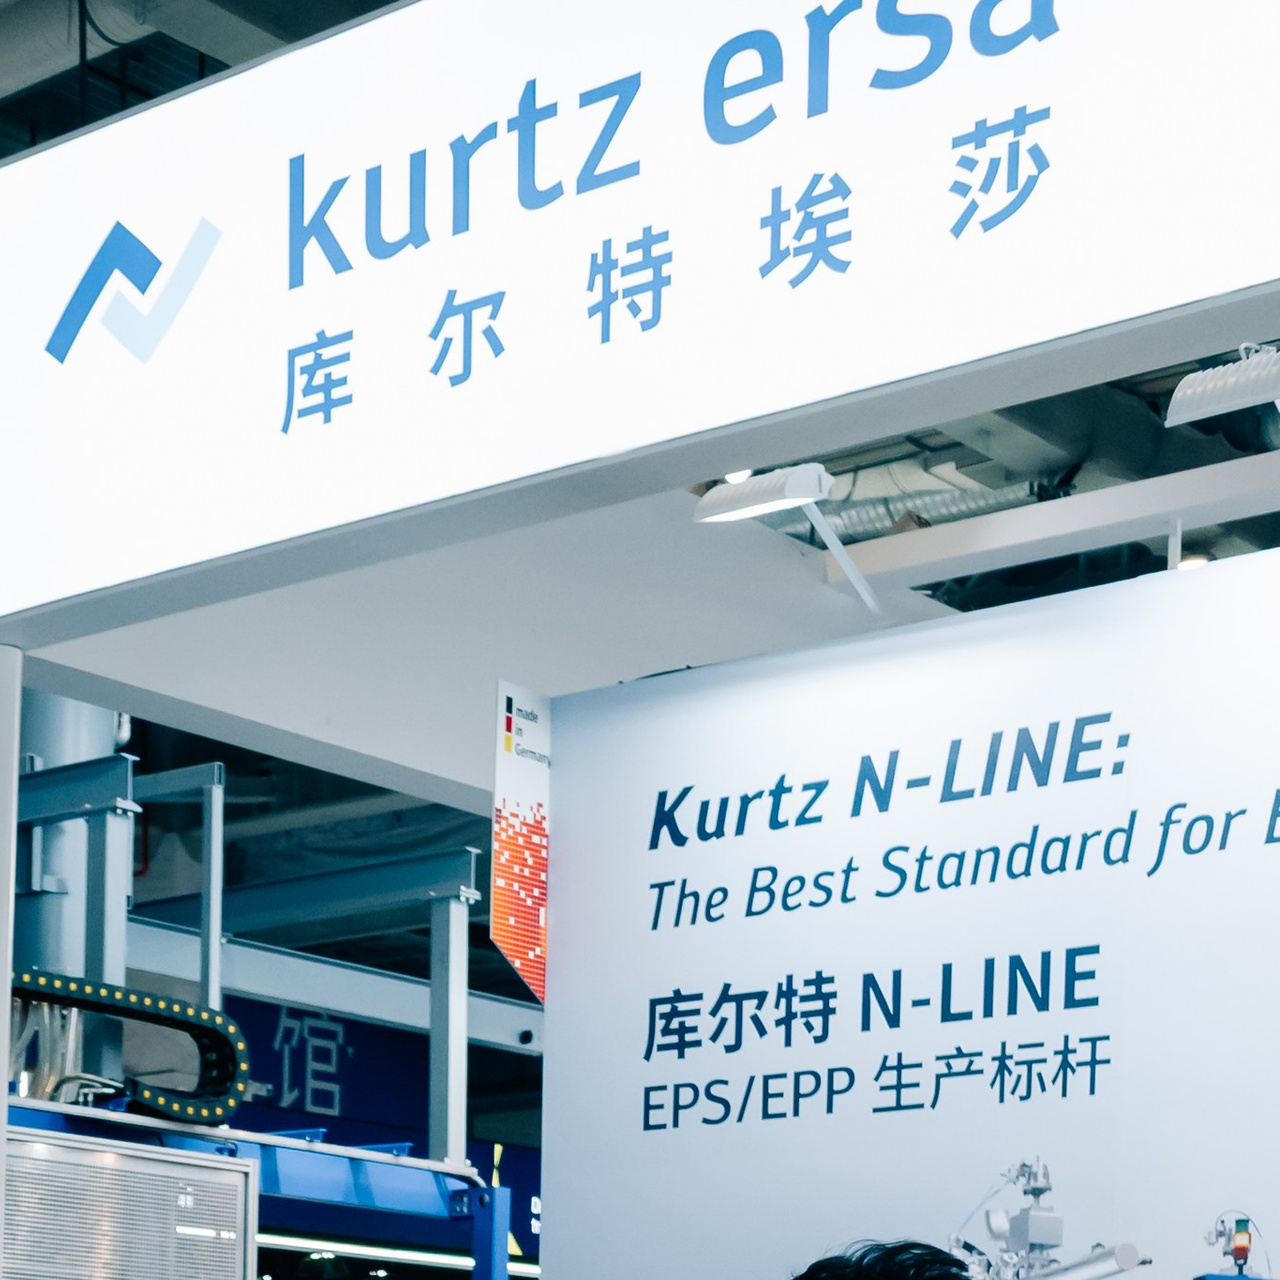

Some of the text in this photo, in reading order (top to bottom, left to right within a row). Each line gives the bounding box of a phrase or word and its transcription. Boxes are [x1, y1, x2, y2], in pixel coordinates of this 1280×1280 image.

[287, 71, 642, 291] kurtz
[648, 712, 1131, 851] Kurtz N-LINE:
[649, 878, 729, 931] The
[744, 856, 859, 918] Best
[875, 810, 1138, 899] Standard
[1146, 802, 1248, 878] for
[642, 944, 1102, 1064] 库尔特 N-LINE
[642, 1033, 1112, 1133] EPS/EPP 生产标杆
